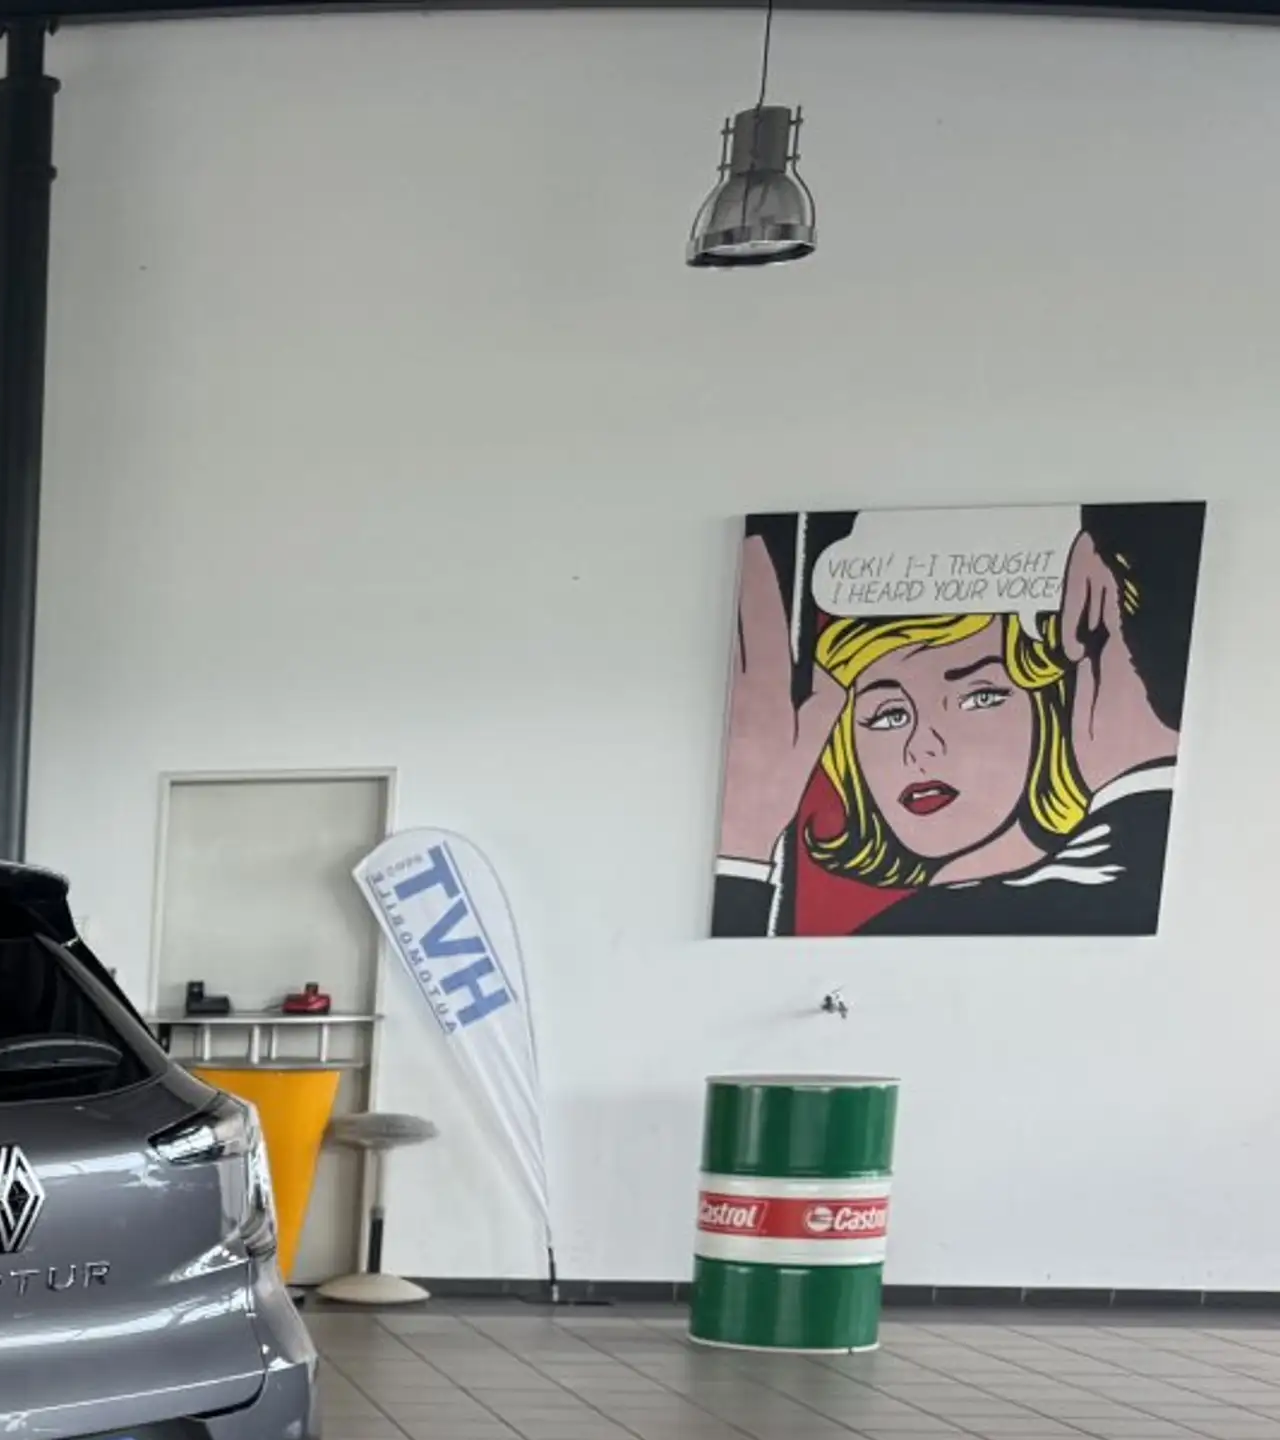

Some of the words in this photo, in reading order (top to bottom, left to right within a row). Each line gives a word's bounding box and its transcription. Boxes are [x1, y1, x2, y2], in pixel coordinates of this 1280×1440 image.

[948, 549, 1056, 577] THOUGHT
[831, 581, 844, 605] I
[847, 579, 926, 604] HEARD
[934, 577, 990, 602] YOUR
